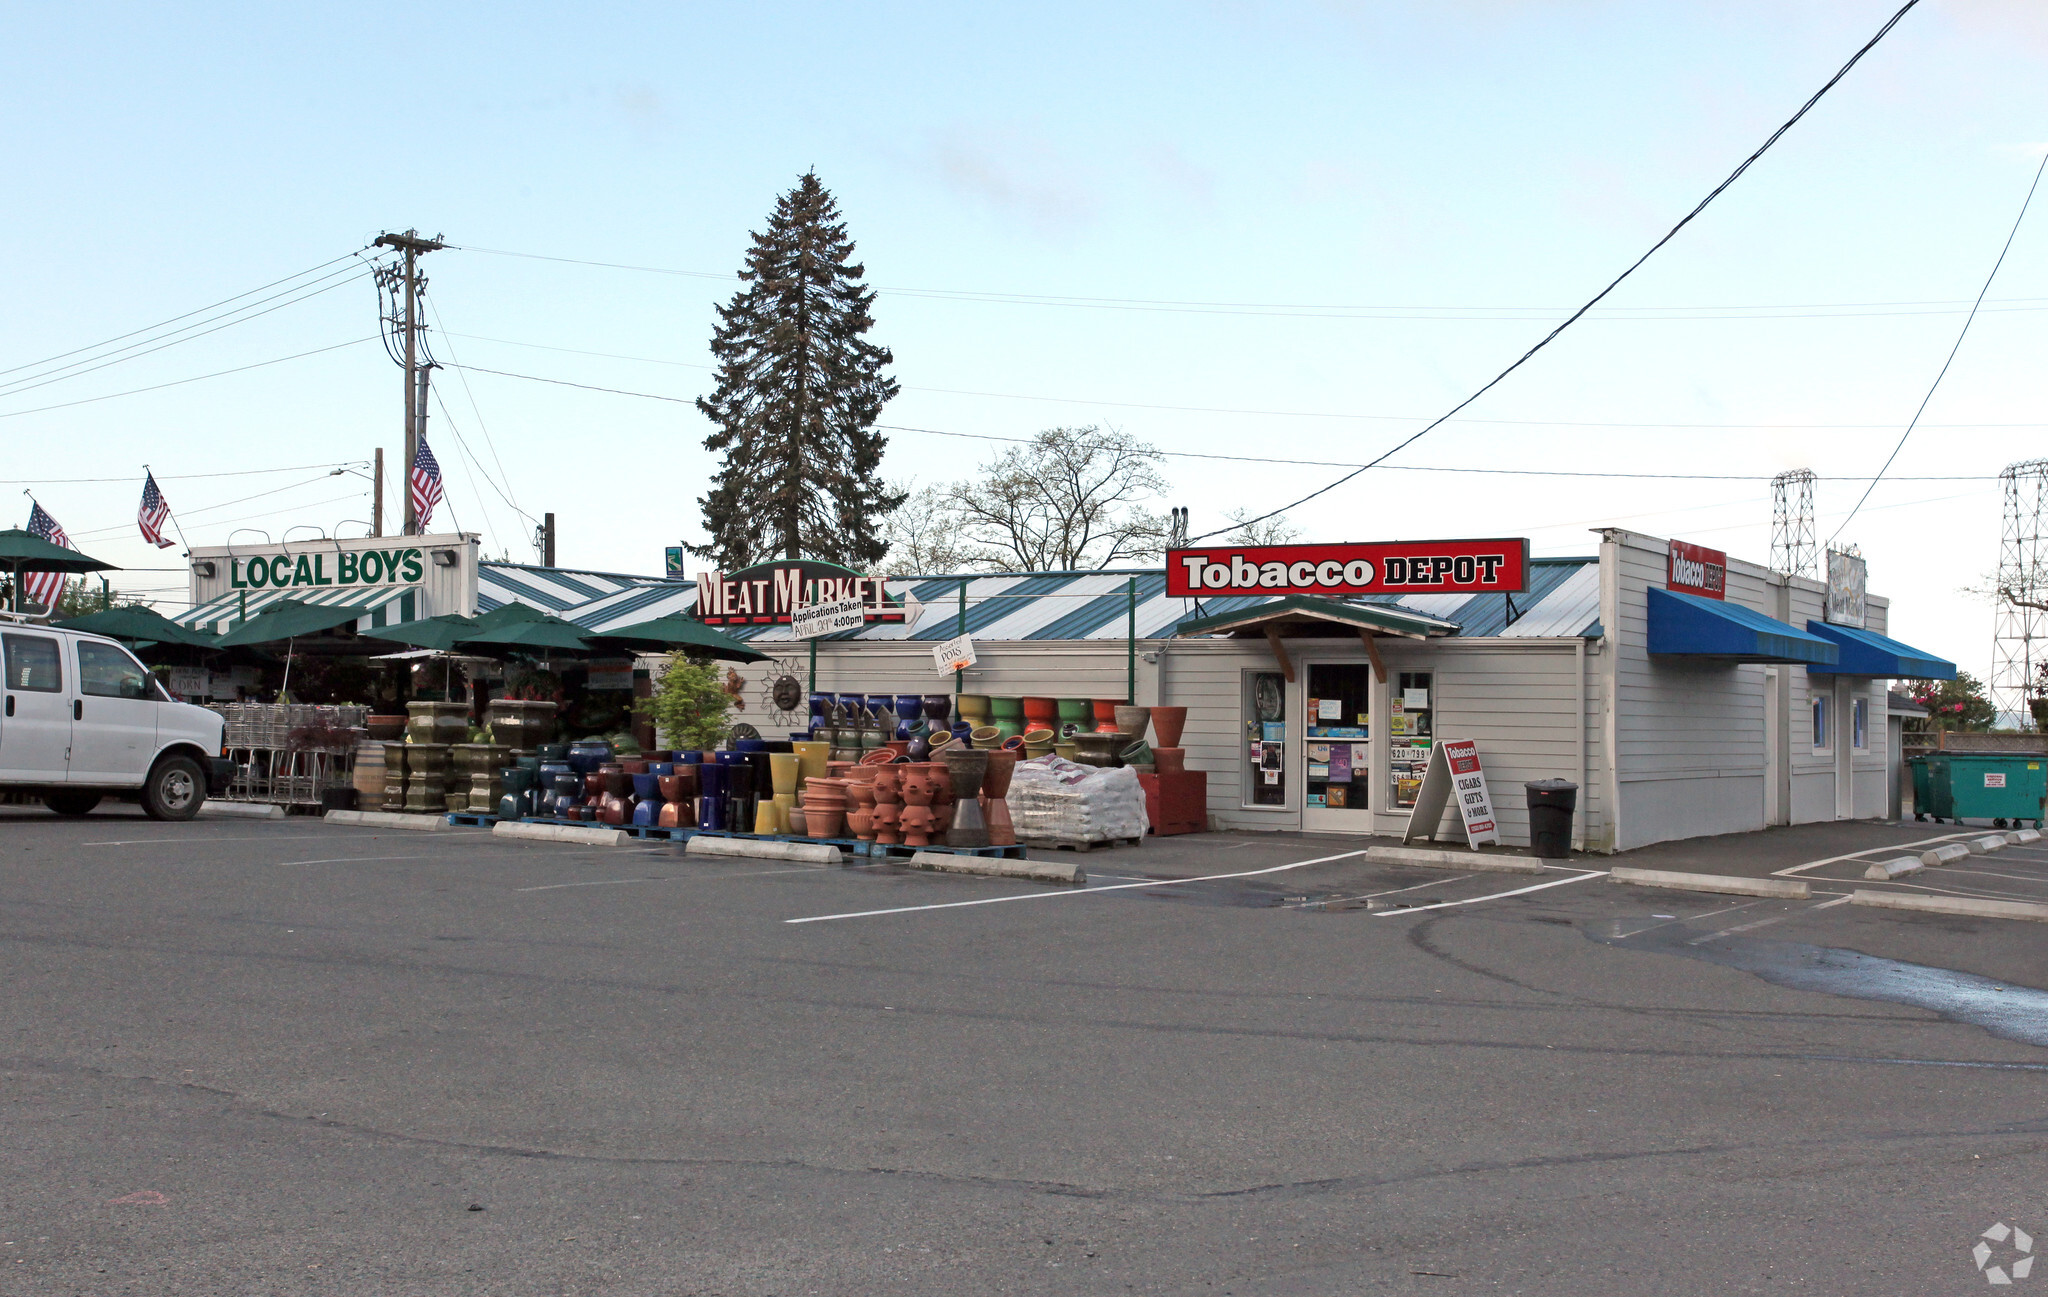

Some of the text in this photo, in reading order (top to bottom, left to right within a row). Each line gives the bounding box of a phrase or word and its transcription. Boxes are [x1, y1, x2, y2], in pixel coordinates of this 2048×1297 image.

[231, 548, 424, 589] LOCAL BOYS
[1182, 553, 1505, 590] Tobacco DEPOT
[1672, 548, 1705, 589] Tobacco
[697, 571, 769, 616] MEAT
[792, 601, 862, 624] Applications Taken
[833, 615, 862, 628] 4:00pm
[941, 646, 962, 662] POTS
[1447, 746, 1476, 760] Tobacco
[1458, 776, 1482, 791] CIGARS
[1464, 791, 1484, 805] GIFTS
[1472, 805, 1489, 817] MORE
